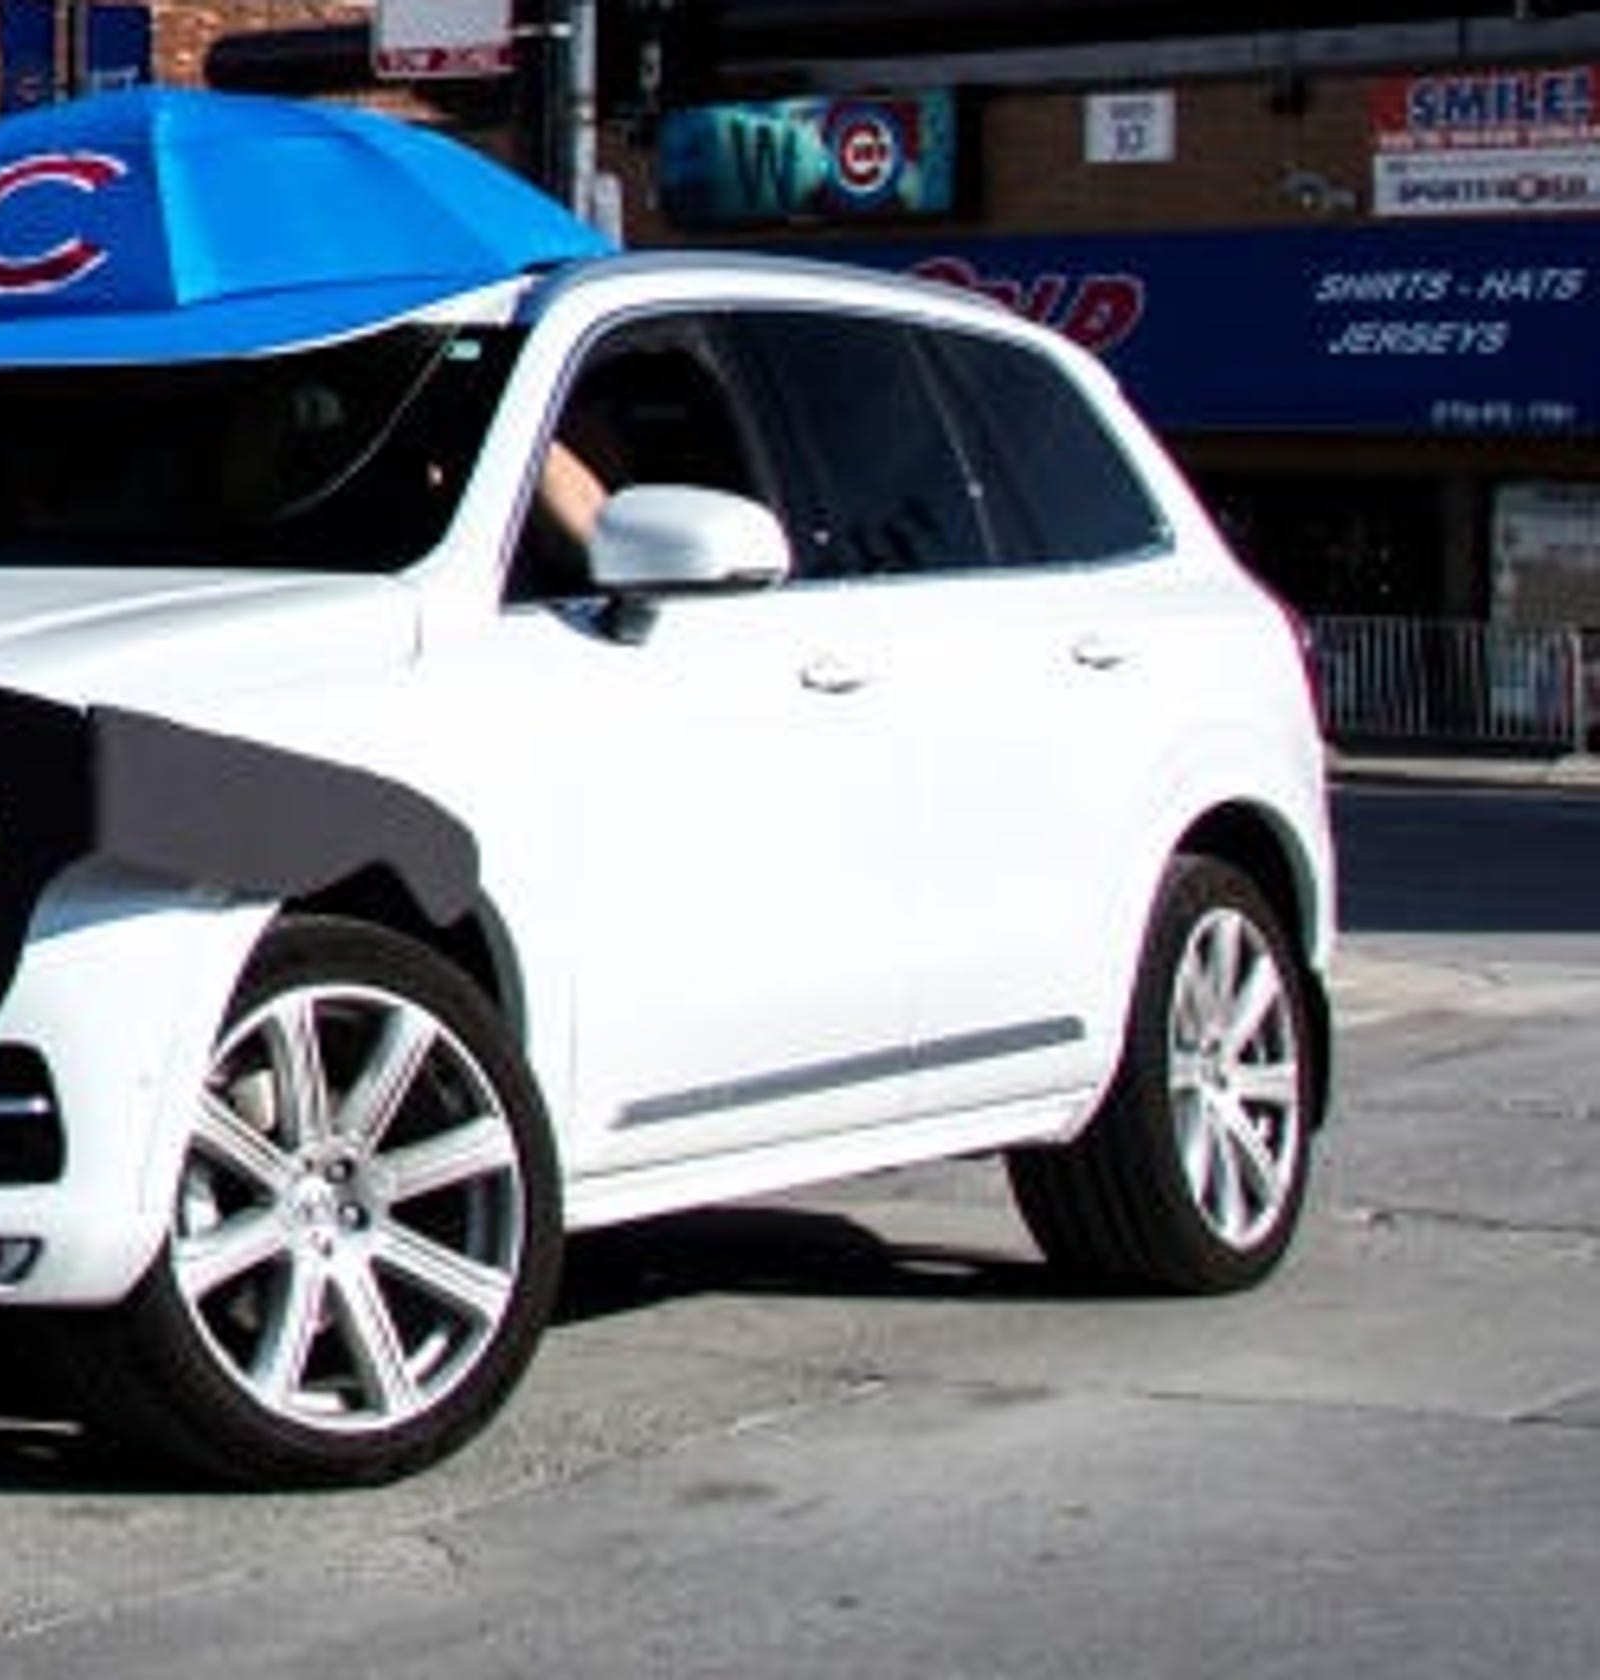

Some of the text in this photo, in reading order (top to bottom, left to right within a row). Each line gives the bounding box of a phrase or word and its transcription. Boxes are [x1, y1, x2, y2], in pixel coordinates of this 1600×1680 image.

[1408, 66, 1590, 132] SMILE!
[1314, 273, 1452, 301] SHIRTS
[1476, 268, 1588, 300] HATS
[1327, 320, 1509, 355] JERSEYS
